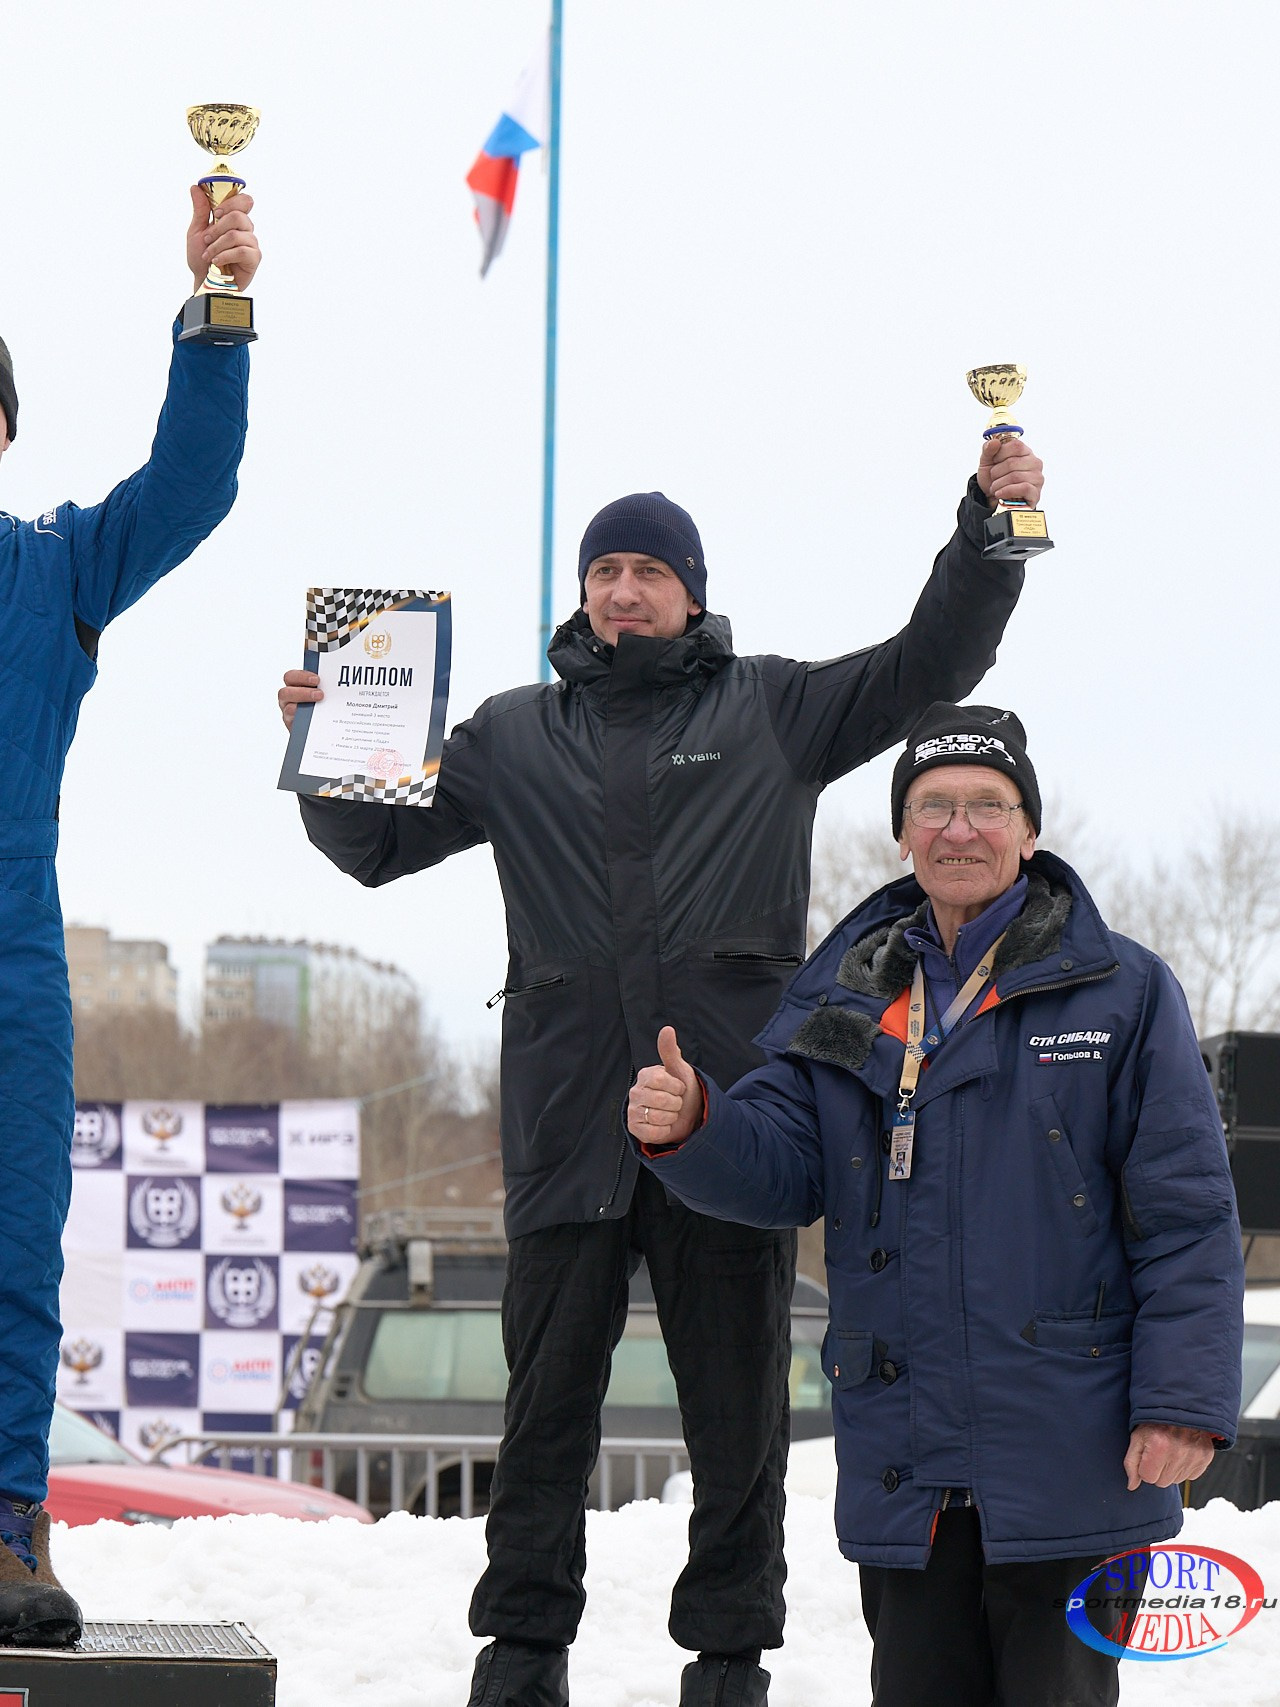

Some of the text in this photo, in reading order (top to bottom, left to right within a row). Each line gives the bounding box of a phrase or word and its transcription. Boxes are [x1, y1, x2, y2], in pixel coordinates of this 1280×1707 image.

[337, 665, 413, 687] ДИПЛОМ
[1029, 1031, 1111, 1046] СТК СИБАДИ
[1053, 1050, 1103, 1061] Гольцов В.
